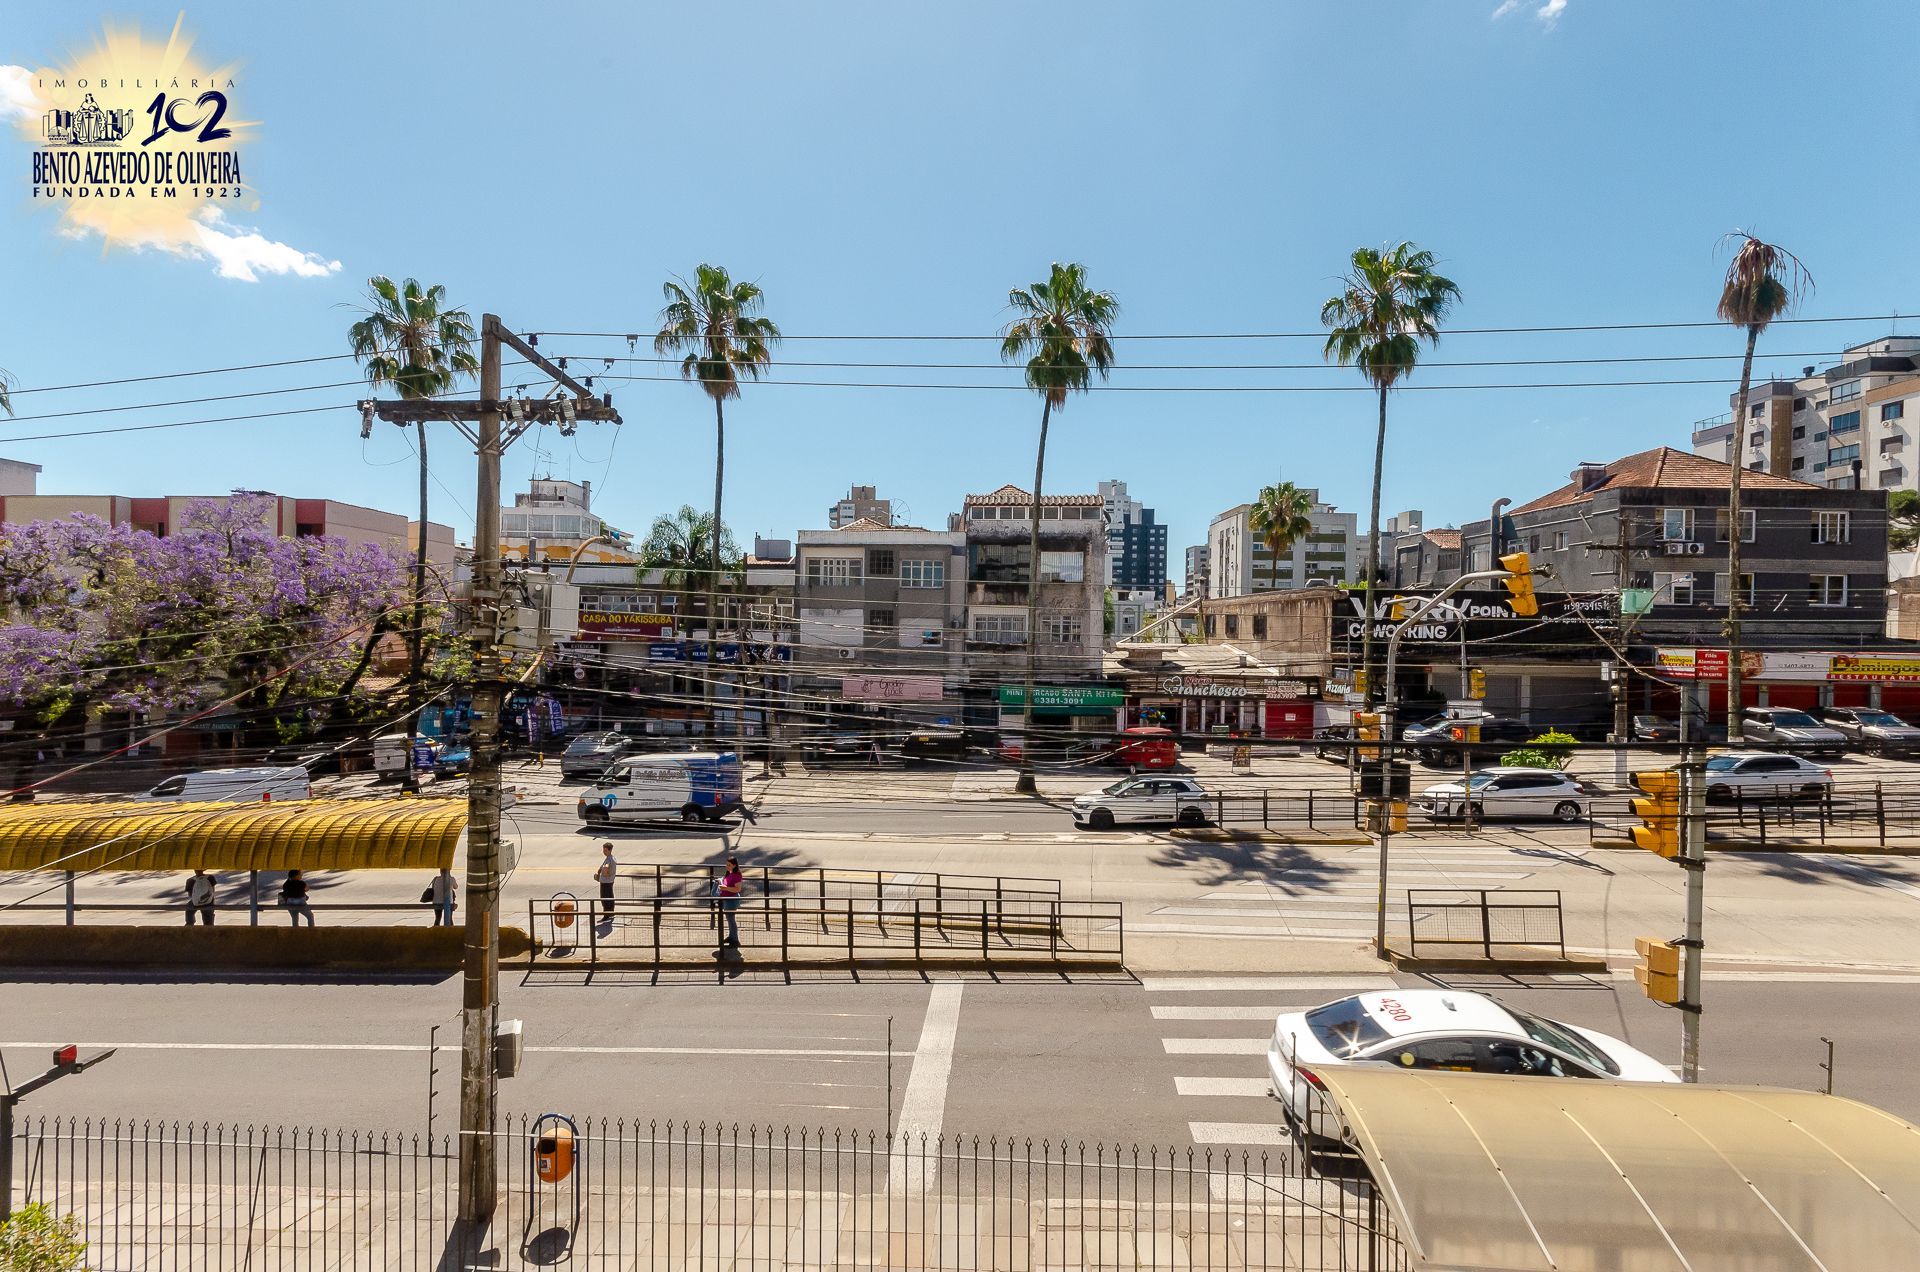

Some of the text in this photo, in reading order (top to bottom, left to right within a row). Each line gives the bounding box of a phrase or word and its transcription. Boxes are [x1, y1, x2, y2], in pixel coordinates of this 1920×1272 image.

[1350, 597, 1517, 621] WRK POIN
[583, 614, 607, 623] CASA
[609, 614, 621, 623] DO
[623, 615, 673, 624] YAKISSOBA
[1349, 623, 1448, 639] CWOKING
[1832, 655, 1920, 674] Domingos
[1033, 689, 1059, 697] ERCADO
[1062, 689, 1092, 697] SANTA
[1380, 998, 1412, 1021] 4280
